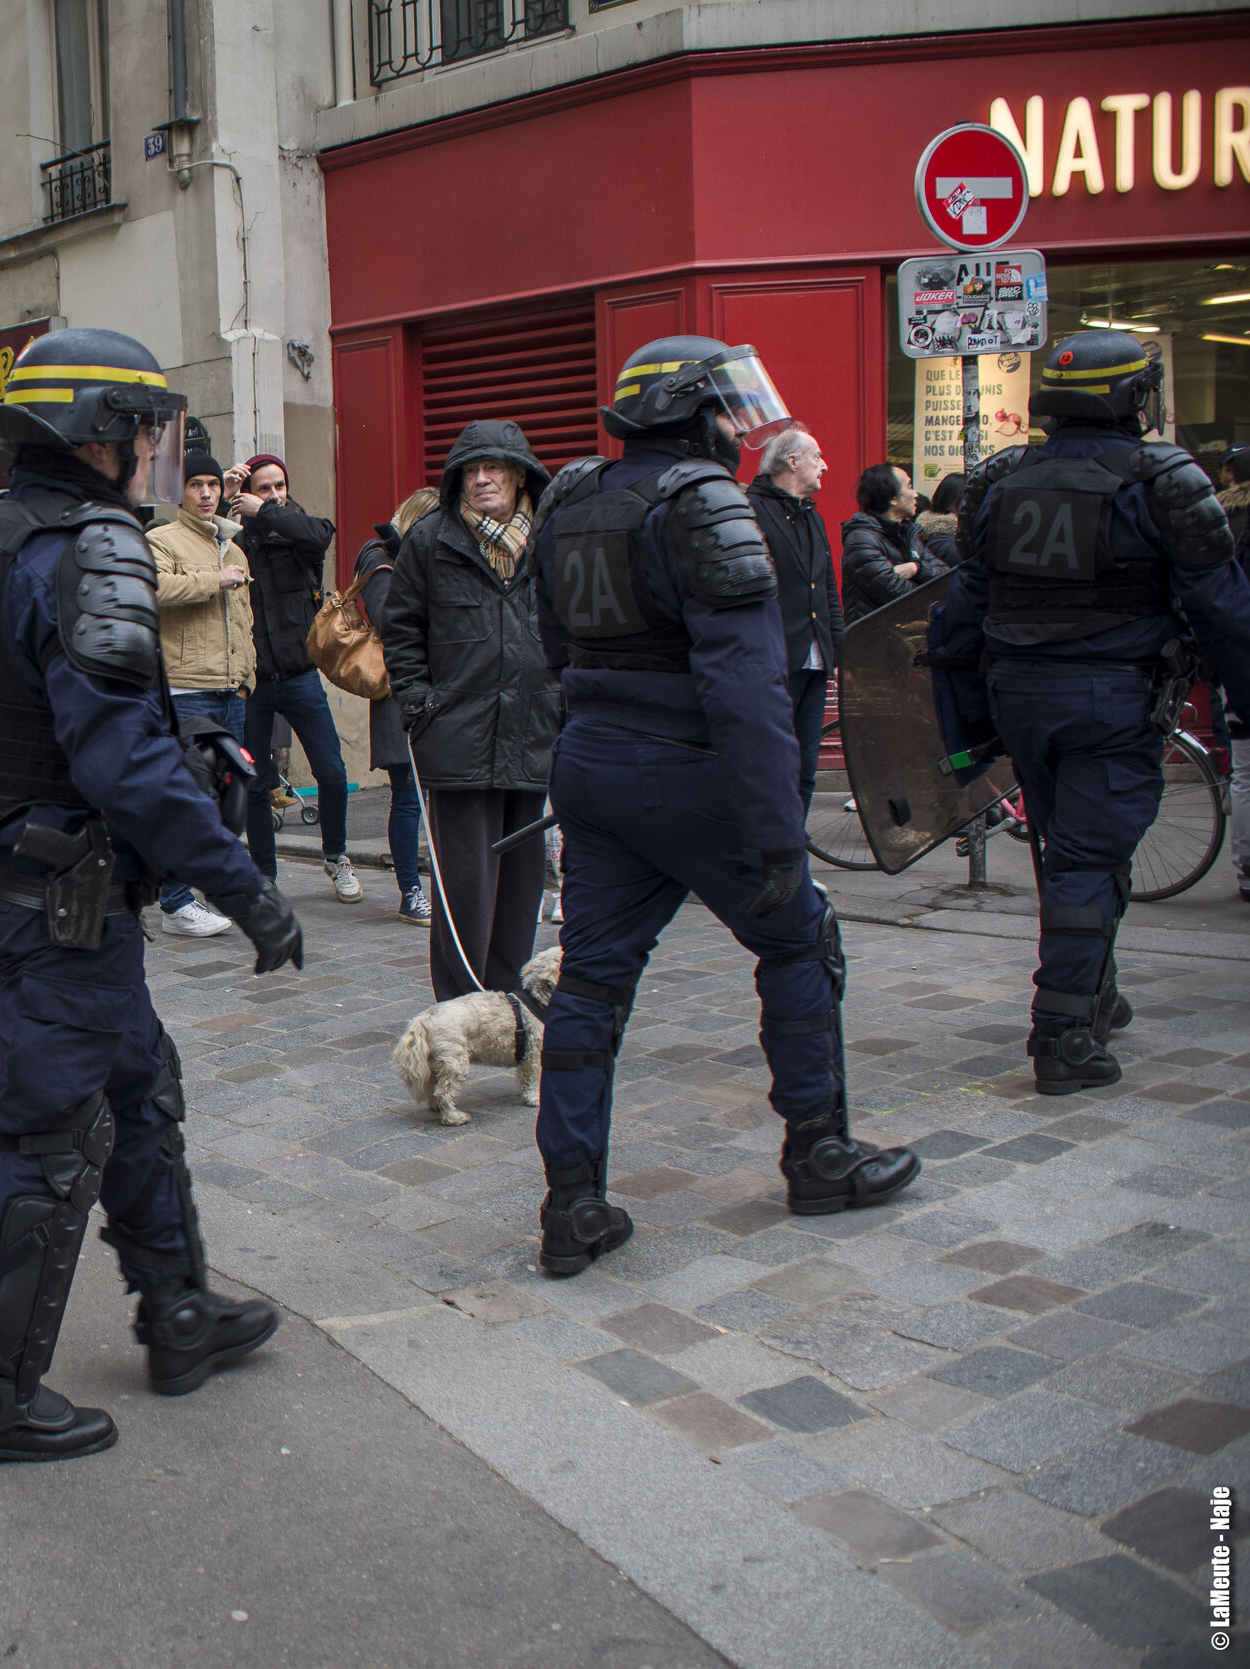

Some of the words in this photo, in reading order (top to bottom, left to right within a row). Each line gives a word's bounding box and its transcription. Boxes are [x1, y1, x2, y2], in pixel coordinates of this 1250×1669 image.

[147, 134, 163, 156] 39
[990, 86, 1250, 198] NATUR
[915, 291, 954, 302] JOKER
[926, 370, 946, 382] QUE
[949, 370, 961, 381] LE
[925, 384, 952, 396] PLUS
[925, 400, 962, 411] PUISSE
[924, 415, 961, 427] MANGE
[924, 430, 954, 441] C'EST
[924, 445, 945, 456] NOS
[1008, 500, 1079, 570] 2A
[563, 547, 629, 627] 2A
